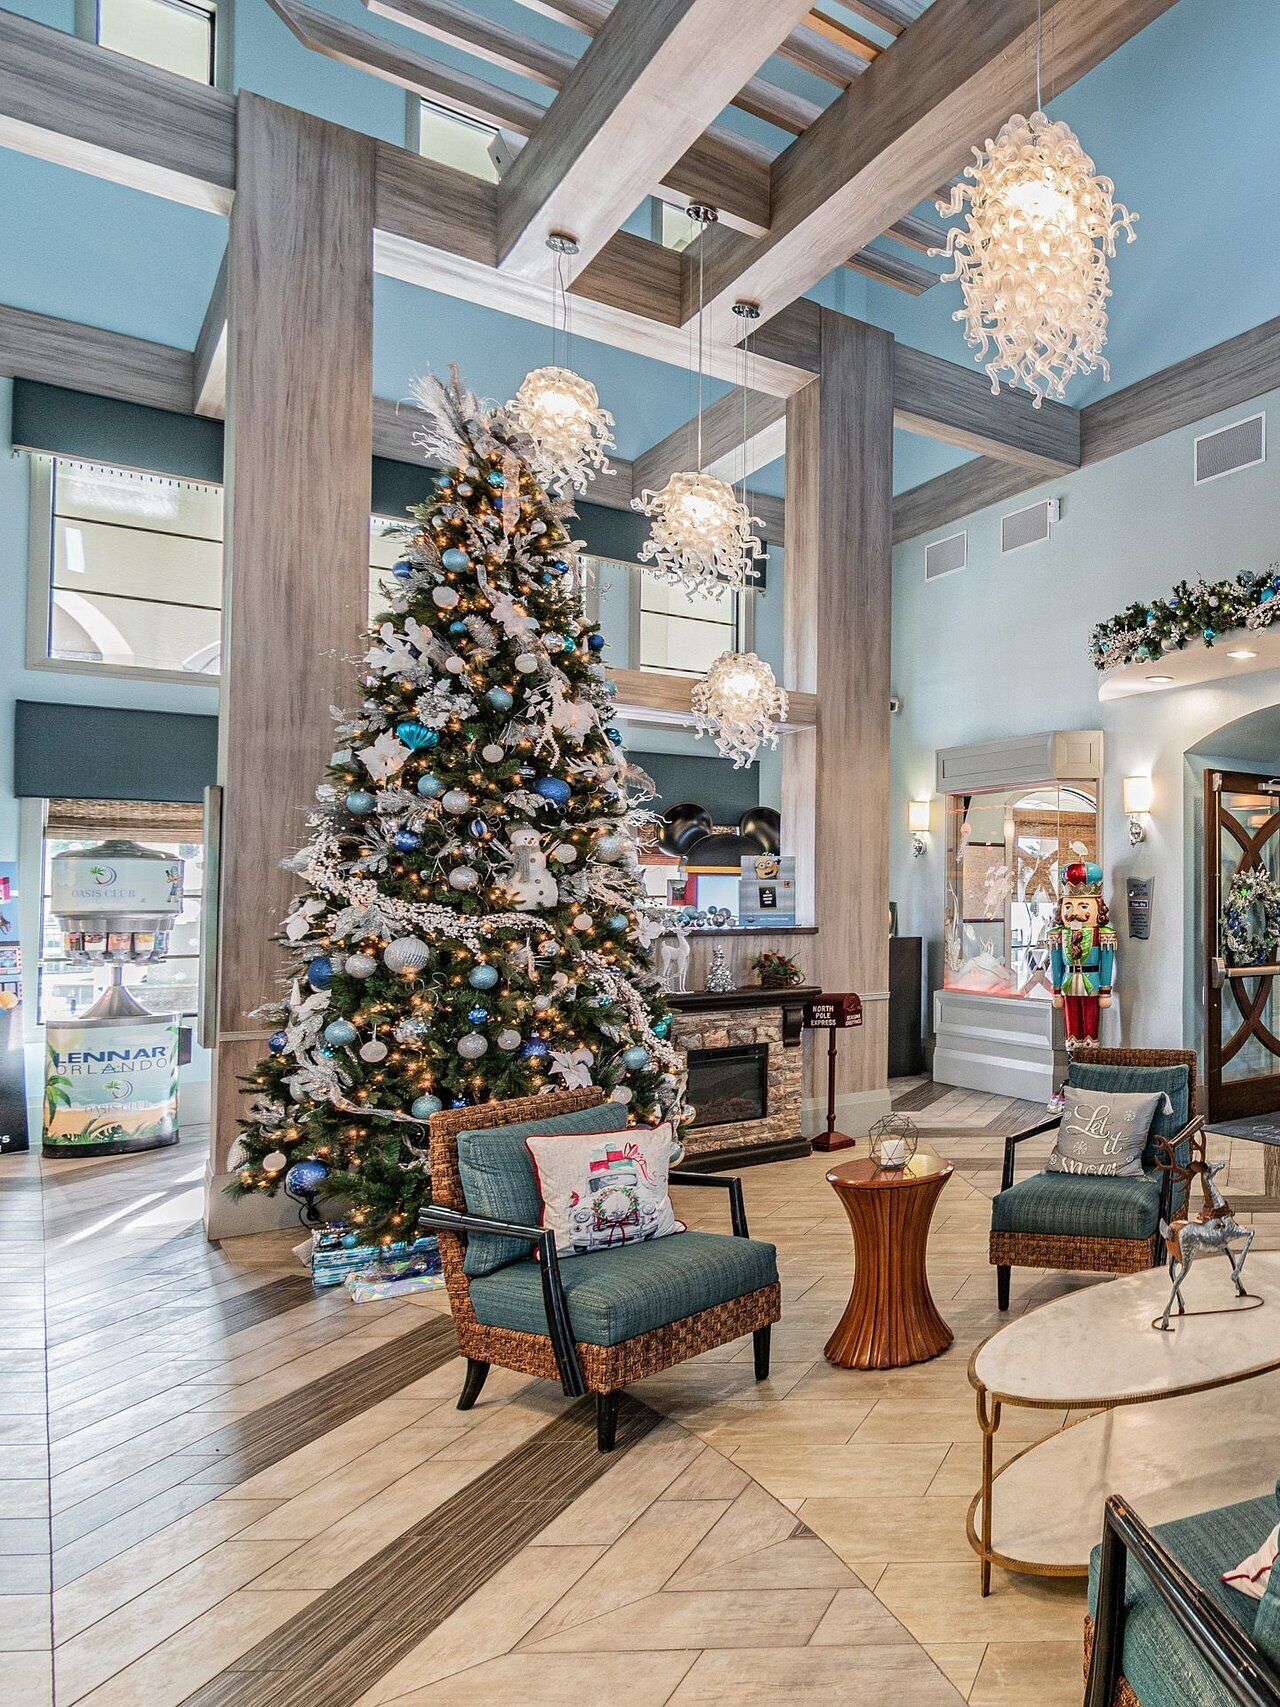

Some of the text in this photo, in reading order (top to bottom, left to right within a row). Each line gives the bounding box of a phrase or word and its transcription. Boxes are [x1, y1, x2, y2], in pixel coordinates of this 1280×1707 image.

[71, 889, 102, 898] OASIS
[56, 1046, 166, 1064] LENNAR
[56, 1058, 167, 1075] ORLANDO
[1066, 1104, 1114, 1139] Let
[1103, 1131, 1129, 1156] it
